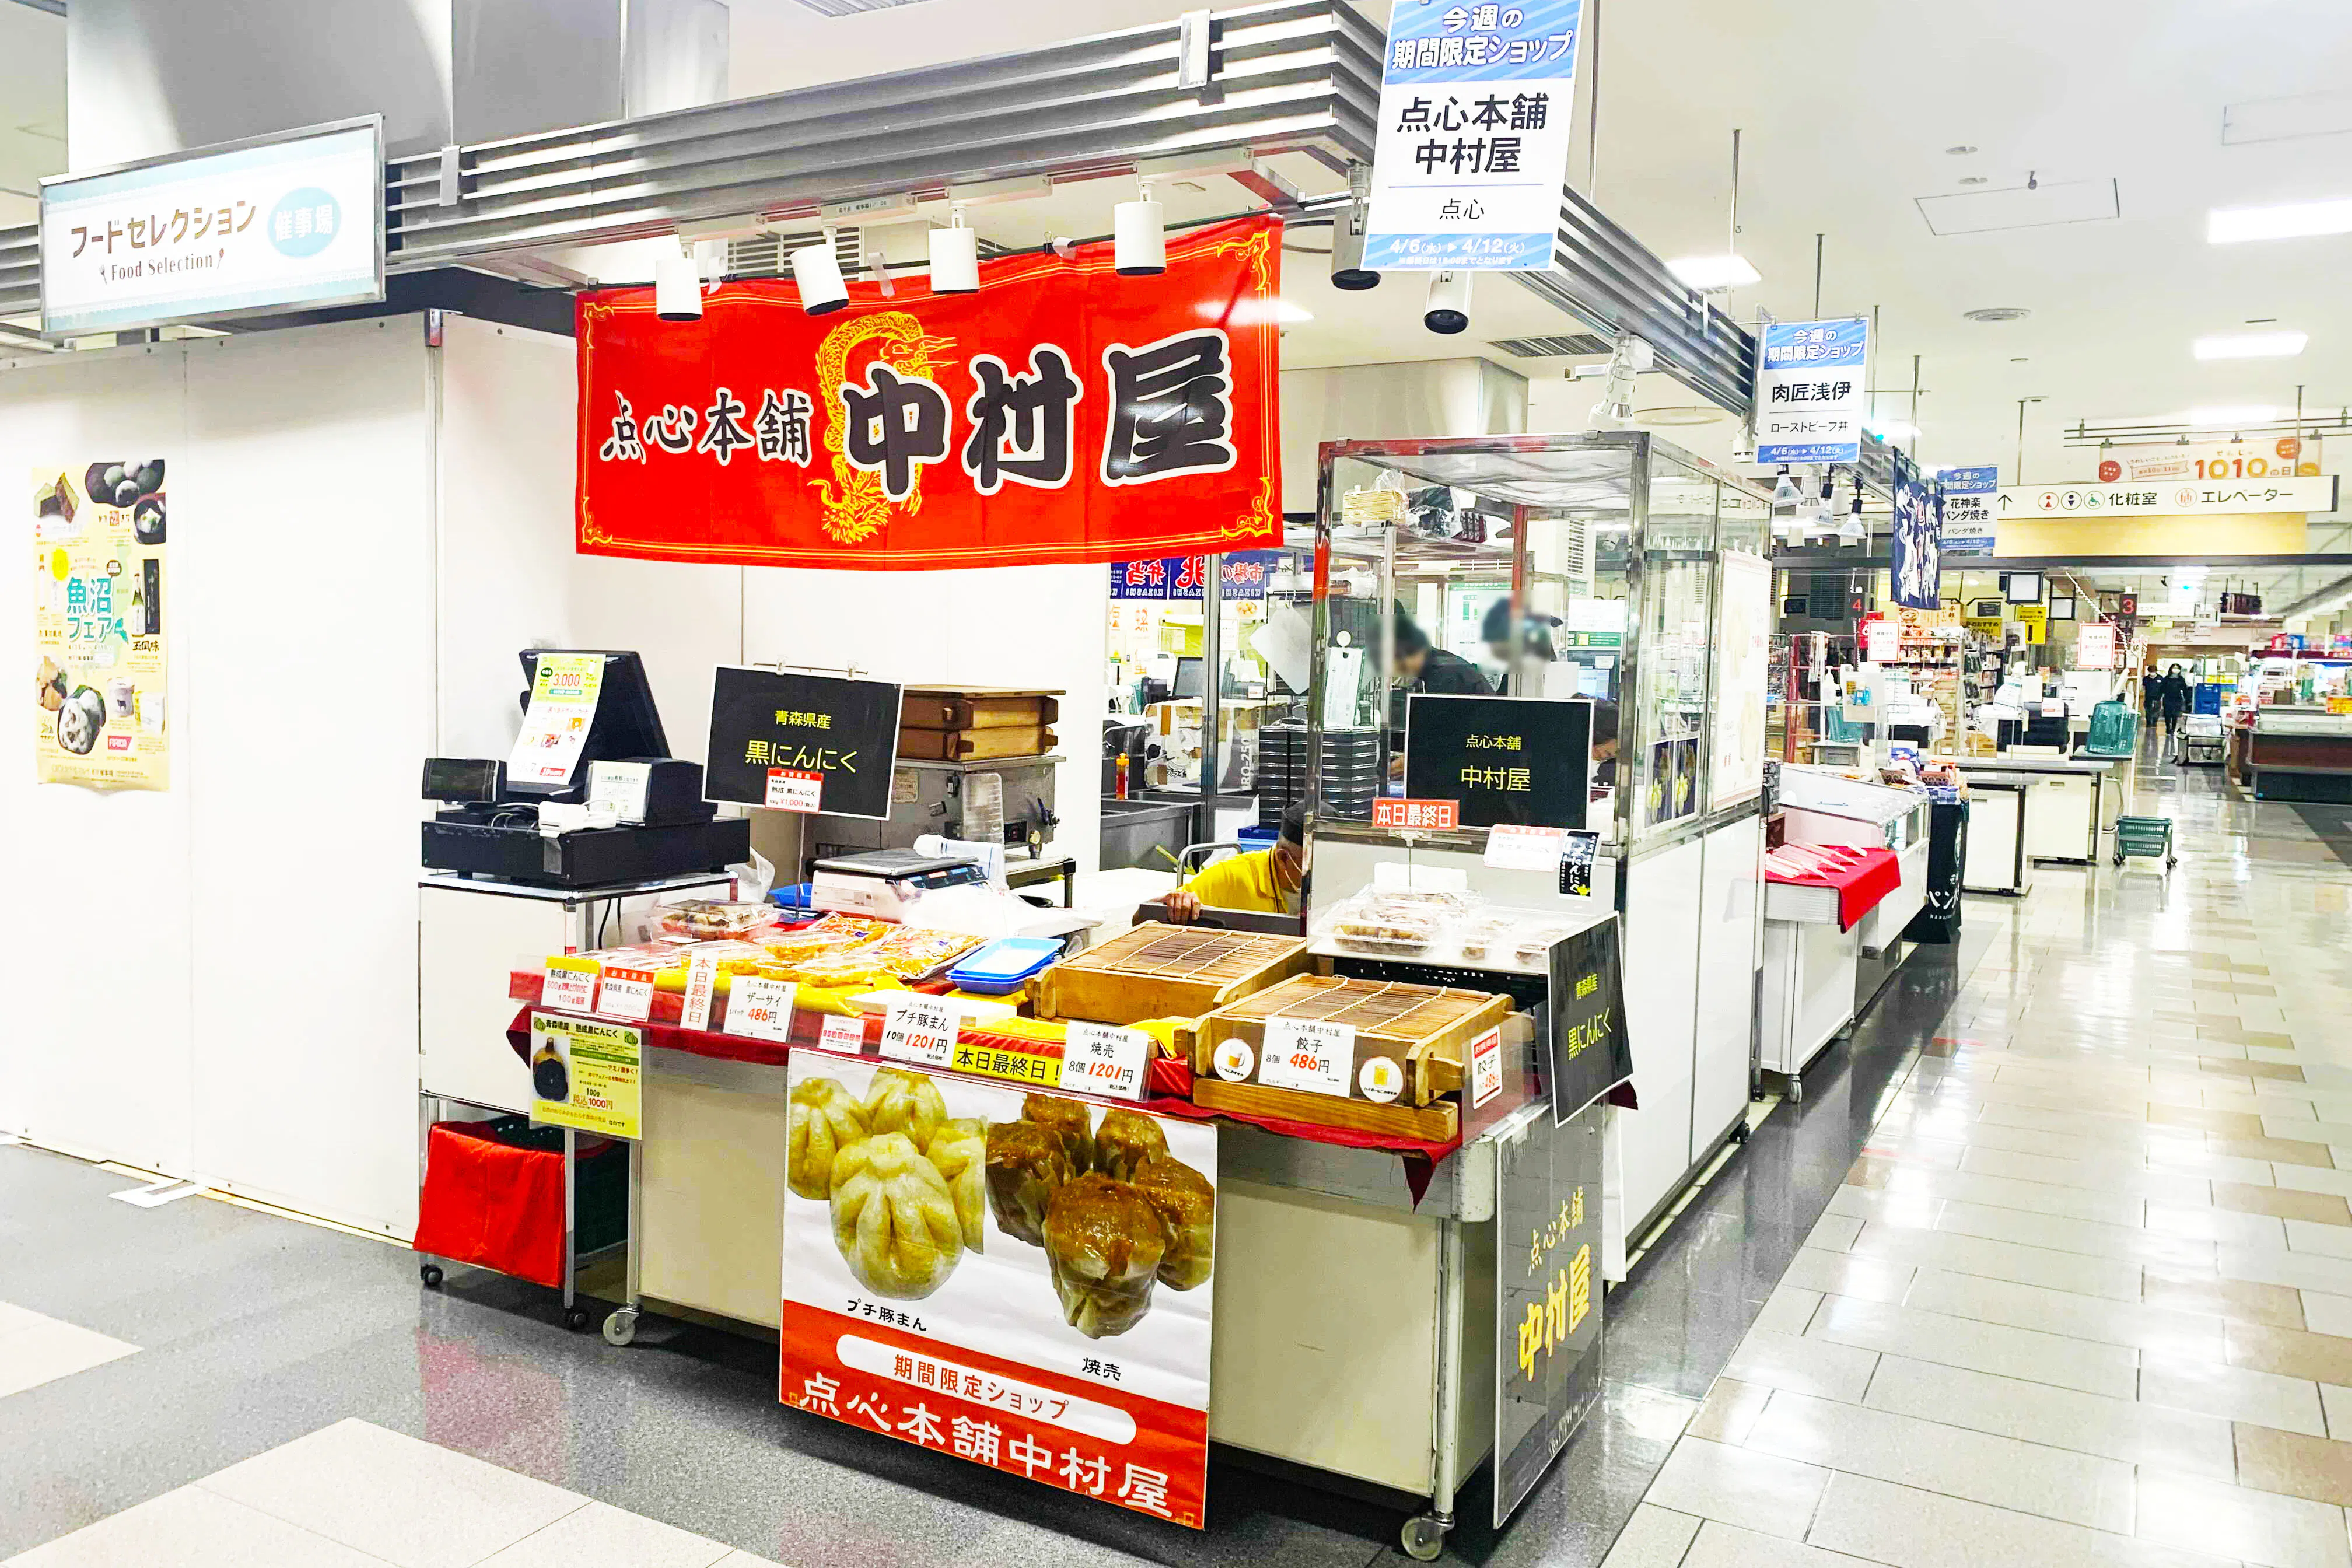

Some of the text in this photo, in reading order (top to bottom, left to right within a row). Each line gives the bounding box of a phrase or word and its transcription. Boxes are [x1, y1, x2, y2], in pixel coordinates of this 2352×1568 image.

[1443, 5, 1524, 33] 今週の
[1391, 30, 1574, 70] 期間限定ショップ
[1396, 92, 1549, 132] 点心本舗
[1415, 137, 1521, 174] 中村屋
[1440, 198, 1485, 220] 点心
[71, 200, 257, 258] フードセレクション
[275, 204, 334, 242] 催事場
[111, 254, 214, 281] Food Selection
[1793, 328, 1837, 344] 今週の
[1768, 341, 1864, 362] 期間限定ショップ
[1772, 381, 1852, 402] 肉匠浅伊
[599, 387, 813, 466] 点心本舗
[842, 328, 1238, 503] 中村屋
[1951, 497, 1980, 509] 花神楽
[2109, 492, 2157, 506] 化粧室
[2201, 489, 2294, 503] エレベーター
[67, 577, 111, 614] 魚沼
[1852, 598, 1863, 611] 4
[2122, 598, 2134, 614] 3
[67, 617, 114, 642] フェア
[775, 710, 831, 729] 青森県産
[1465, 734, 1522, 751] 点心本舗
[745, 739, 858, 773] 黒にんにく
[1461, 765, 1531, 792] 中村屋
[1376, 803, 1452, 828] 本日最終日
[550, 969, 590, 982] 熟成黒にんにく
[1576, 972, 1598, 1001] 青森県産
[688, 957, 712, 1024] 本日最終日
[747, 992, 781, 1007] ザーサイ
[747, 1008, 778, 1024] 486円
[895, 1009, 950, 1031] プチ豚まん
[1082, 1028, 1129, 1043] 点心本舗中村屋
[1283, 1021, 1340, 1037] 点心本舗中村屋
[1568, 1007, 1613, 1062] 黒にんにく
[886, 1031, 948, 1054] 10個 1201円
[1090, 1041, 1115, 1058] 焼売
[1296, 1037, 1323, 1054] 餃子
[1068, 1060, 1133, 1084] 8個 1201円
[1266, 1054, 1330, 1074] 8個 486円
[1527, 1186, 1584, 1278] 点心本舗
[847, 1297, 928, 1332] プチ豚まん
[1518, 1243, 1590, 1381] 中村屋
[1082, 1356, 1122, 1382] 焼売
[894, 1353, 1070, 1420] 期間限定ショップ
[800, 1371, 1172, 1519] 点心本舗中村屋
